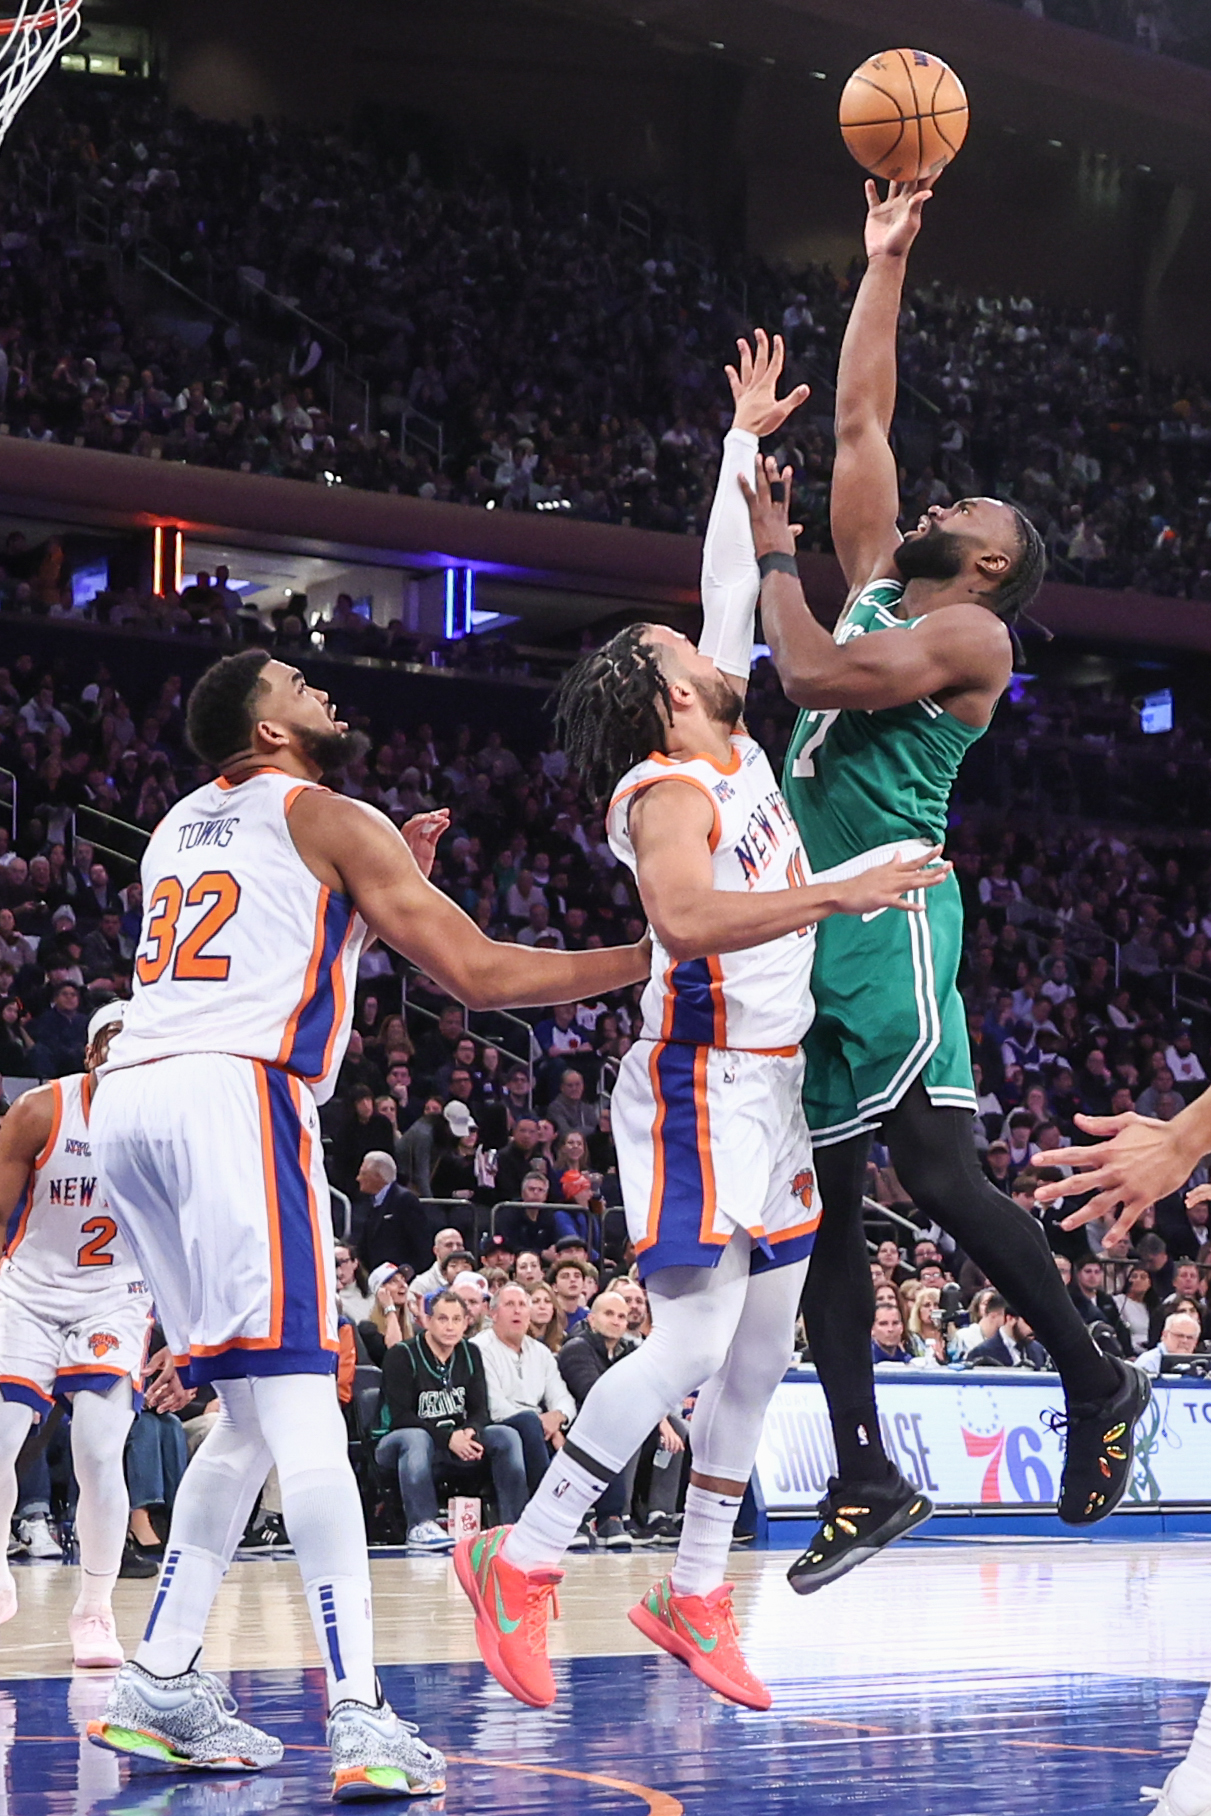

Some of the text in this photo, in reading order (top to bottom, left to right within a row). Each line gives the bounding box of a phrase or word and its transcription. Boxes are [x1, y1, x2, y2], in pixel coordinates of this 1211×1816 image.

[792, 708, 841, 778] 7
[177, 818, 240, 853] TOWNS
[734, 804, 780, 890] NEW
[136, 870, 241, 986] 32
[50, 1176, 97, 1207] NEW
[77, 1215, 117, 1267] 2
